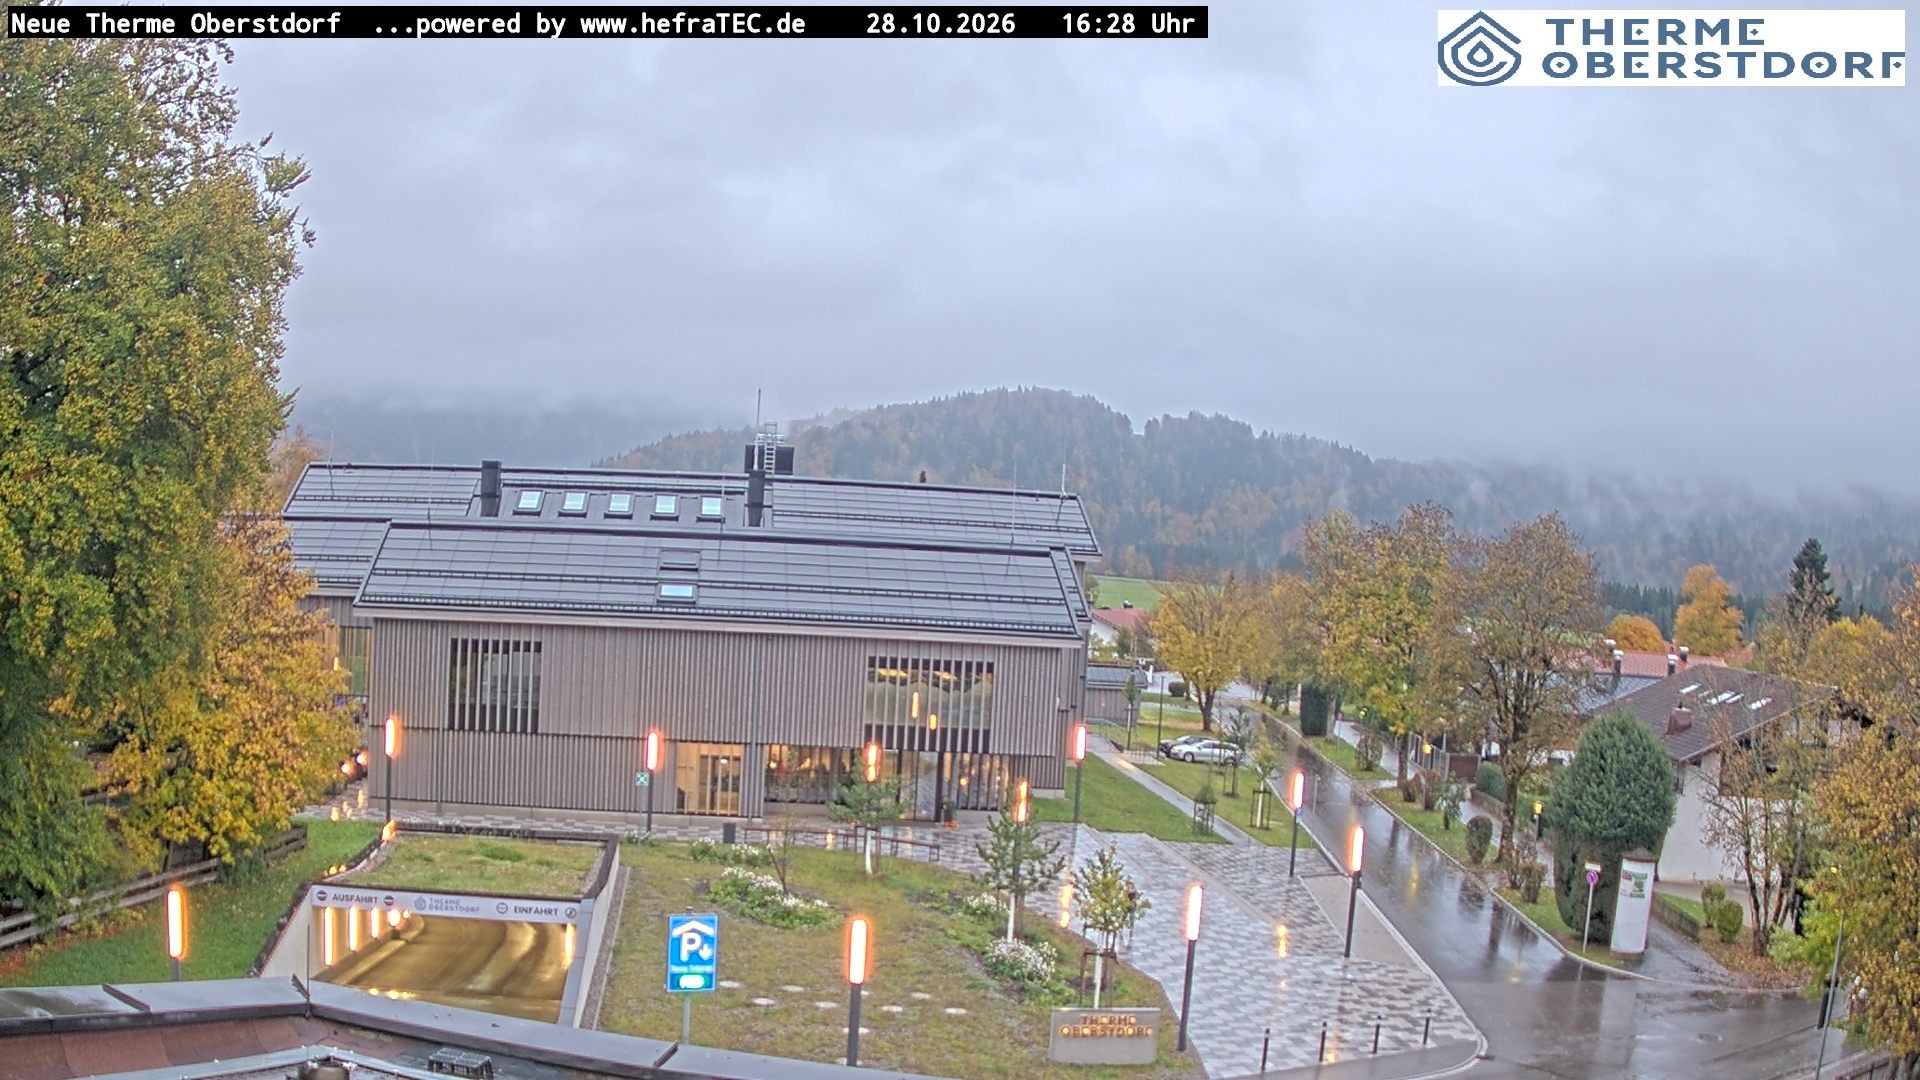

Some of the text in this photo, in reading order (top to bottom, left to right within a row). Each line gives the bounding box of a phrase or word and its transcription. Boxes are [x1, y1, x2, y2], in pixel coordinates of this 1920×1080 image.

[332, 893, 378, 904] AUSFAHRT
[514, 905, 558, 916] EINFAHRT
[680, 932, 702, 962] P
[1080, 1014, 1136, 1025] THERME
[1060, 1025, 1153, 1038] OBERSTDORF
